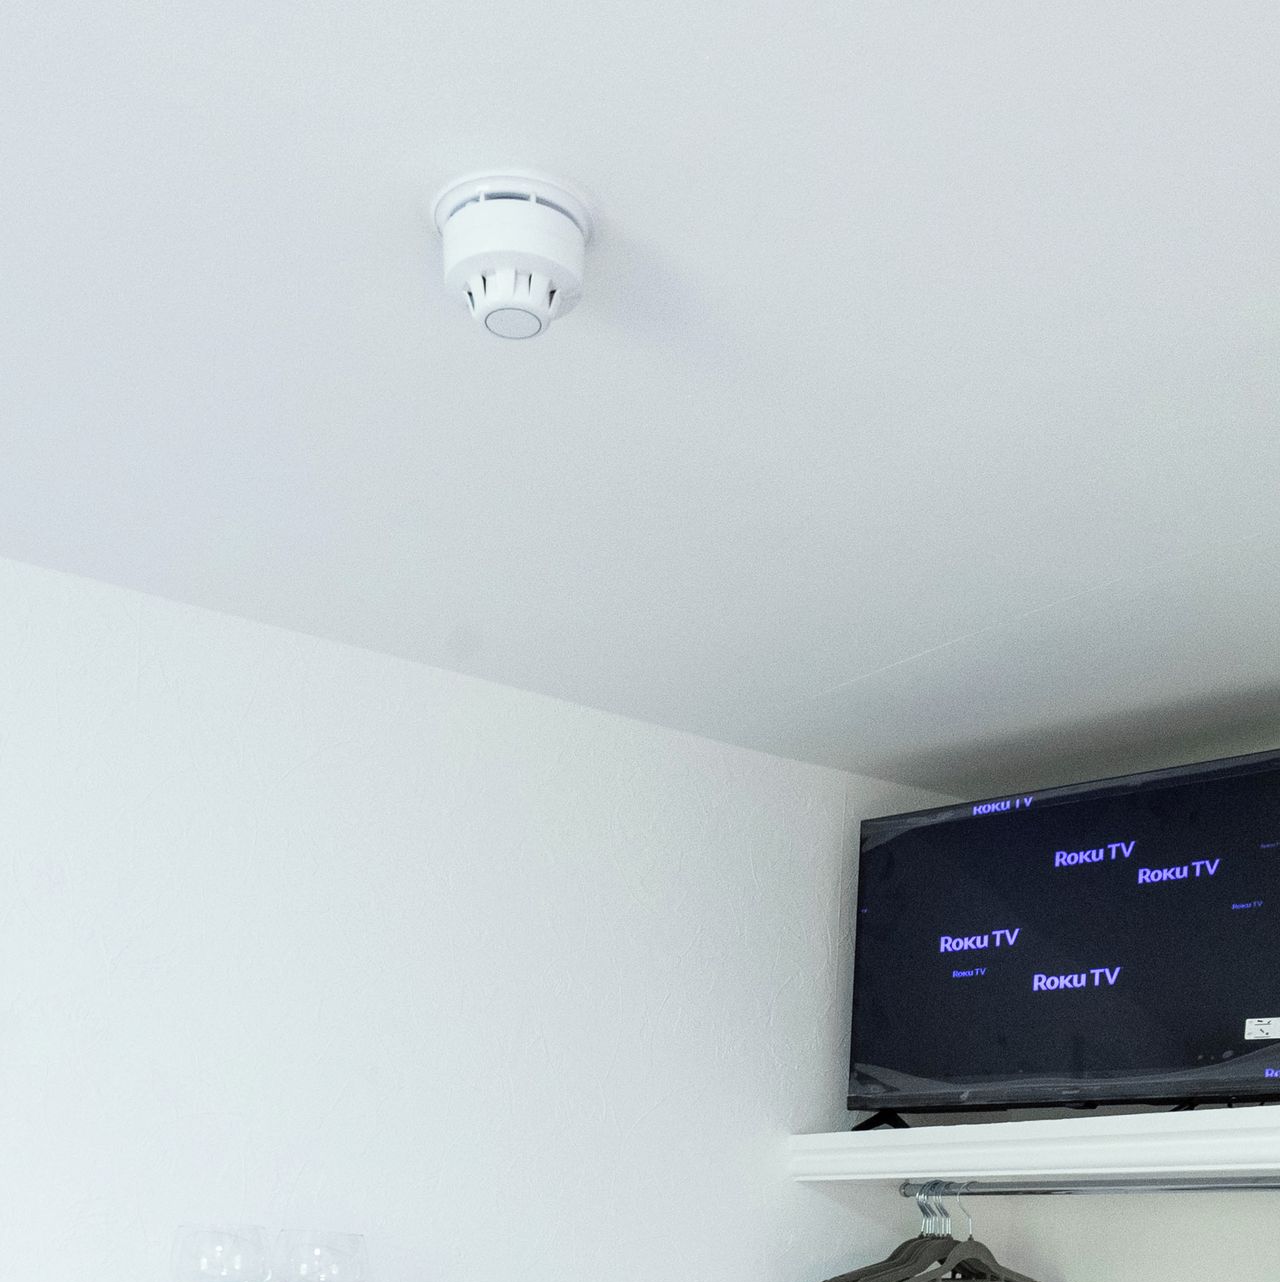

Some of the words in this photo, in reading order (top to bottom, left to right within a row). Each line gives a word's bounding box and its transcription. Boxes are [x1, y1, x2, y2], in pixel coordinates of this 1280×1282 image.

[1054, 847, 1104, 867] Roku
[1108, 841, 1135, 860] TV
[1137, 865, 1189, 884] Roku
[1192, 858, 1220, 876] TV
[940, 935, 988, 953] Roku
[992, 928, 1020, 947] TV
[952, 969, 973, 978] Roku
[974, 967, 986, 976] TV
[1032, 973, 1086, 991] Roku
[1090, 966, 1121, 986] TV
